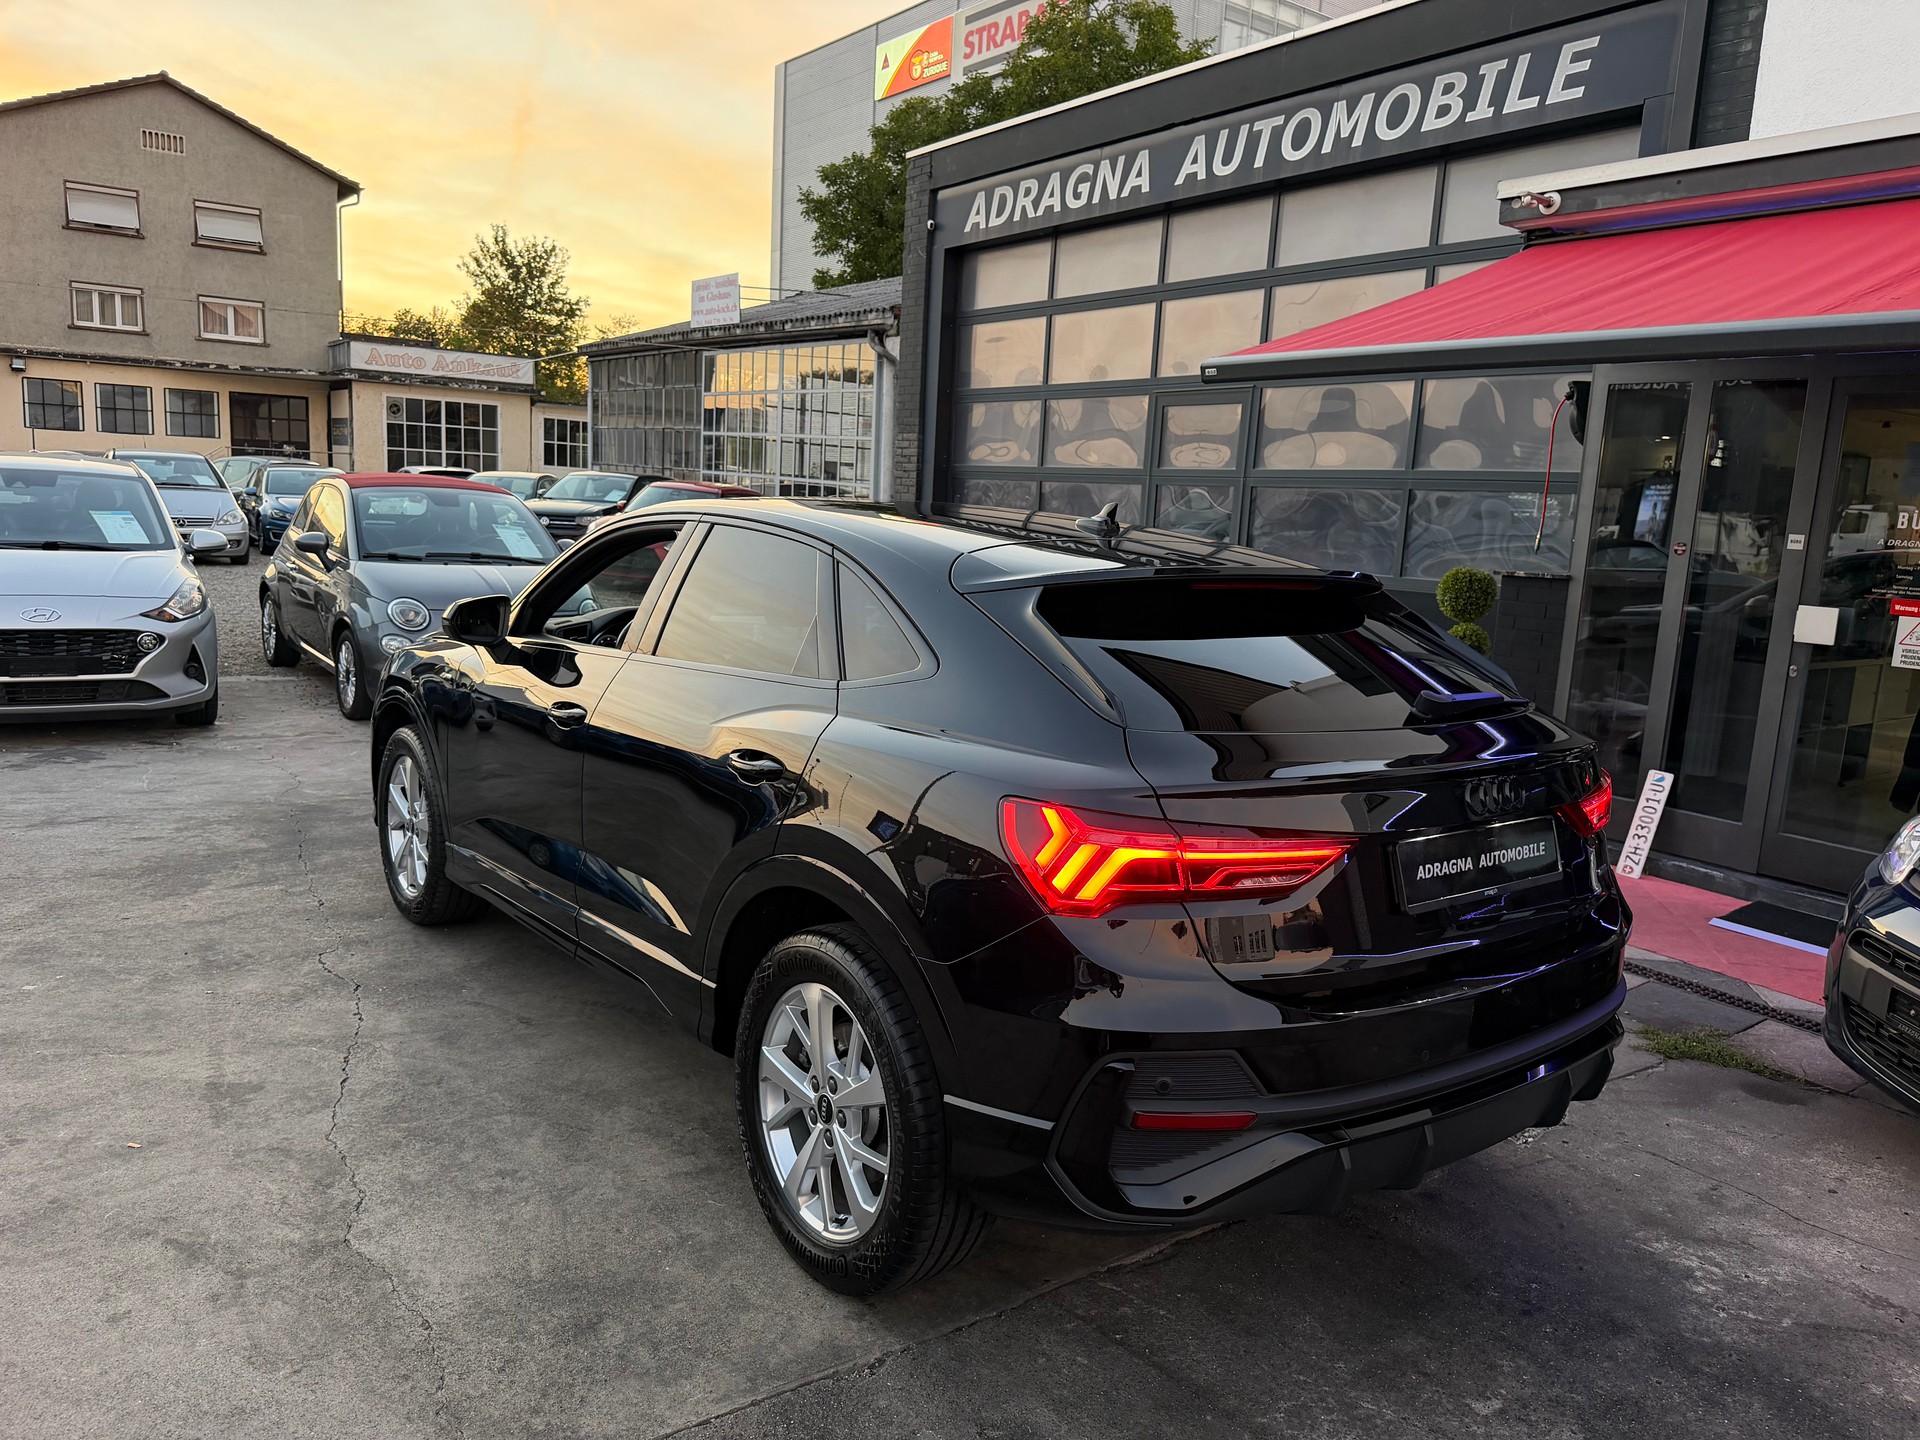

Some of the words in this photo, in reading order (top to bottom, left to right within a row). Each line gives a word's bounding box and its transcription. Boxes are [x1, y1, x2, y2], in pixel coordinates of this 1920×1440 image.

[963, 0, 1068, 60] STRAB
[963, 149, 1150, 233] ADRAGNA
[1174, 35, 1600, 186] AUTOMOBILE
[365, 348, 426, 370] Auto
[1894, 604, 1918, 613] Warnung
[1416, 857, 1474, 881] ADRAGNA
[1478, 841, 1546, 869] AUTOMOBILE
[777, 954, 839, 984] Continental
[785, 1228, 849, 1279] Continental
